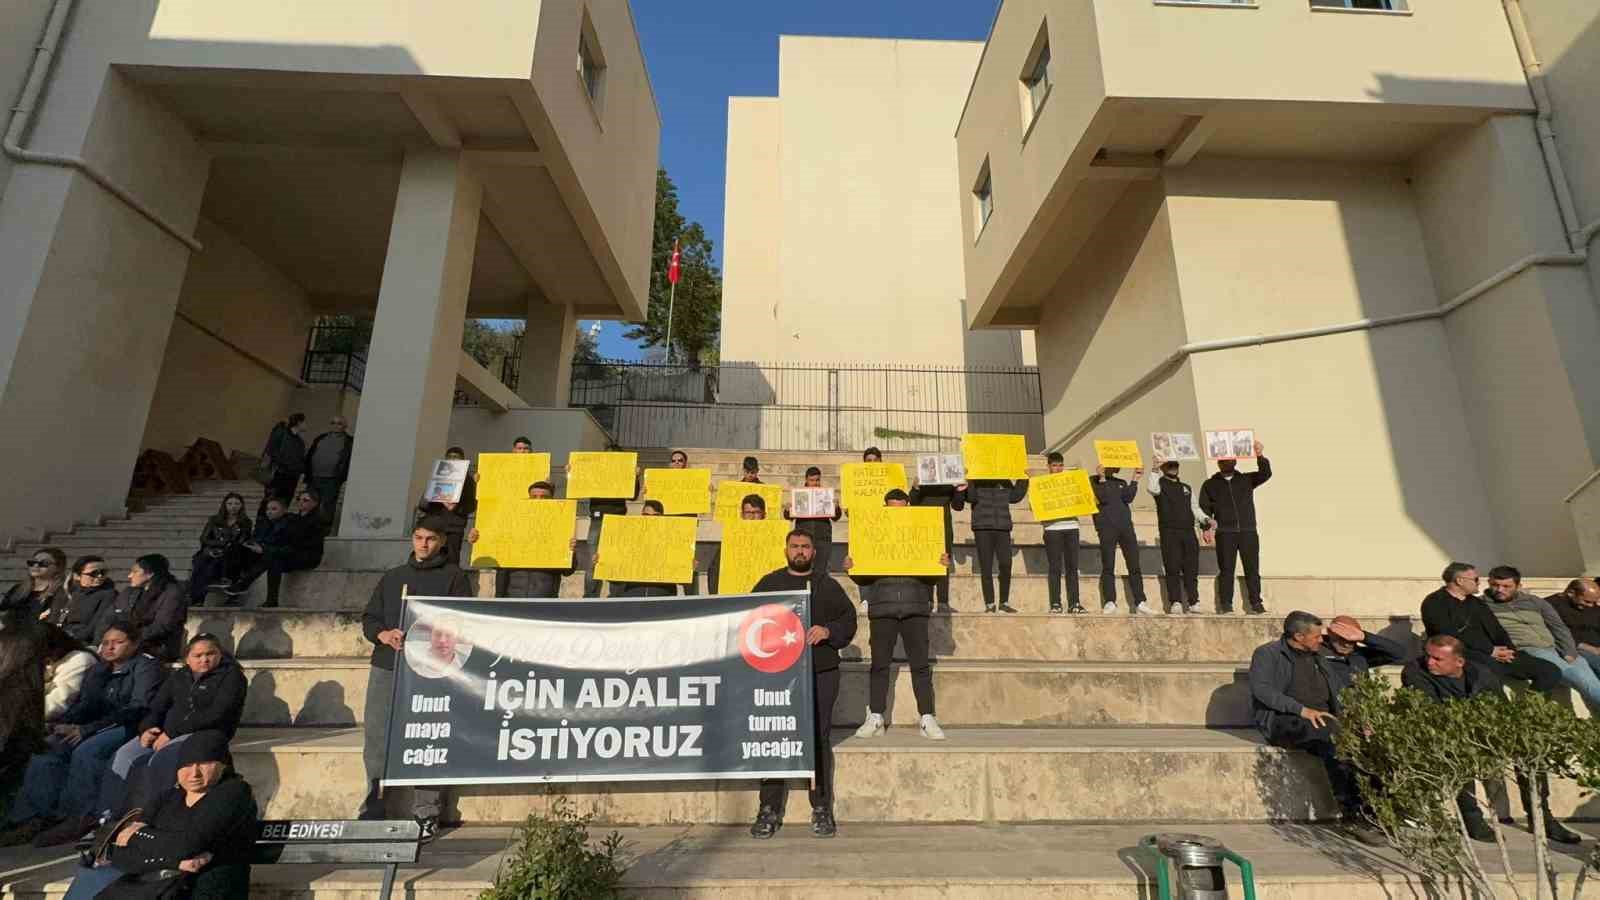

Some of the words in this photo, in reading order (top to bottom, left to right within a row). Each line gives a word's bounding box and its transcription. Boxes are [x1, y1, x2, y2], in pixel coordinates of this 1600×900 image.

[411, 694, 451, 713] Unut
[483, 670, 565, 719] İÇİN
[575, 676, 722, 709] ADALET
[755, 688, 792, 707] Unut
[404, 721, 451, 741] maya
[748, 713, 797, 732] turma
[496, 718, 704, 761] İSTİYORUZ
[742, 737, 804, 760] yacağız
[402, 744, 449, 767] cağız
[262, 820, 345, 839] BELEDİYESİ
